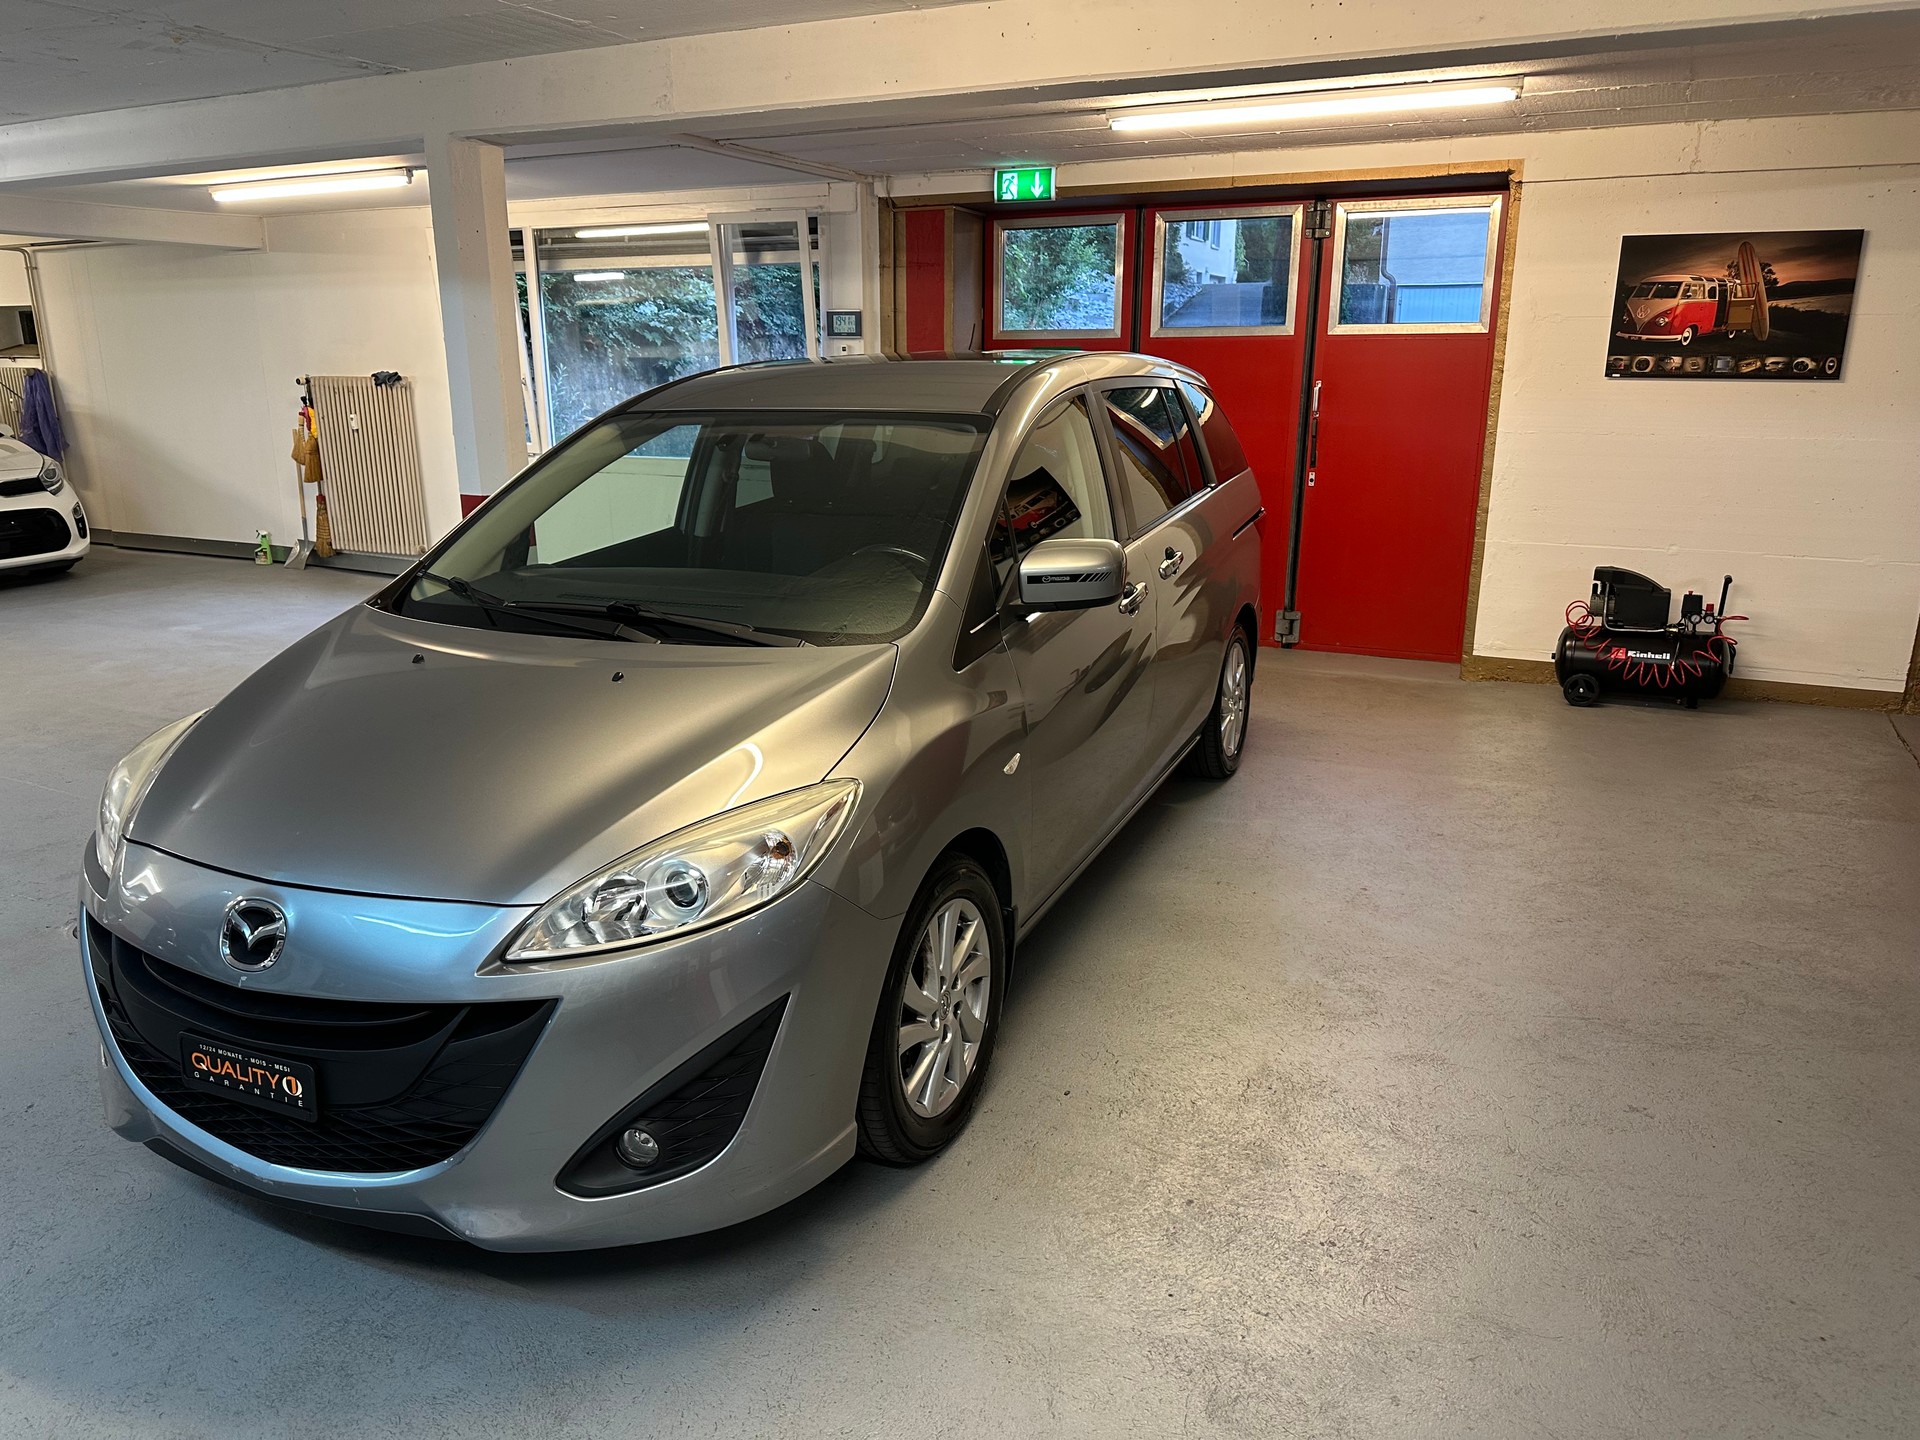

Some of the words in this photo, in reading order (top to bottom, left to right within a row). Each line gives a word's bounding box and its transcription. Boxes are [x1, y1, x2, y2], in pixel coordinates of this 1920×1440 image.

[1627, 650, 1671, 660] Einhell
[191, 1052, 279, 1089] QUALITY
[199, 1044, 216, 1053] 12/24
[218, 1048, 243, 1061] MONATE
[250, 1057, 267, 1067] MOIS
[274, 1063, 291, 1073] MESI
[193, 1071, 303, 1107] GARANTIE
